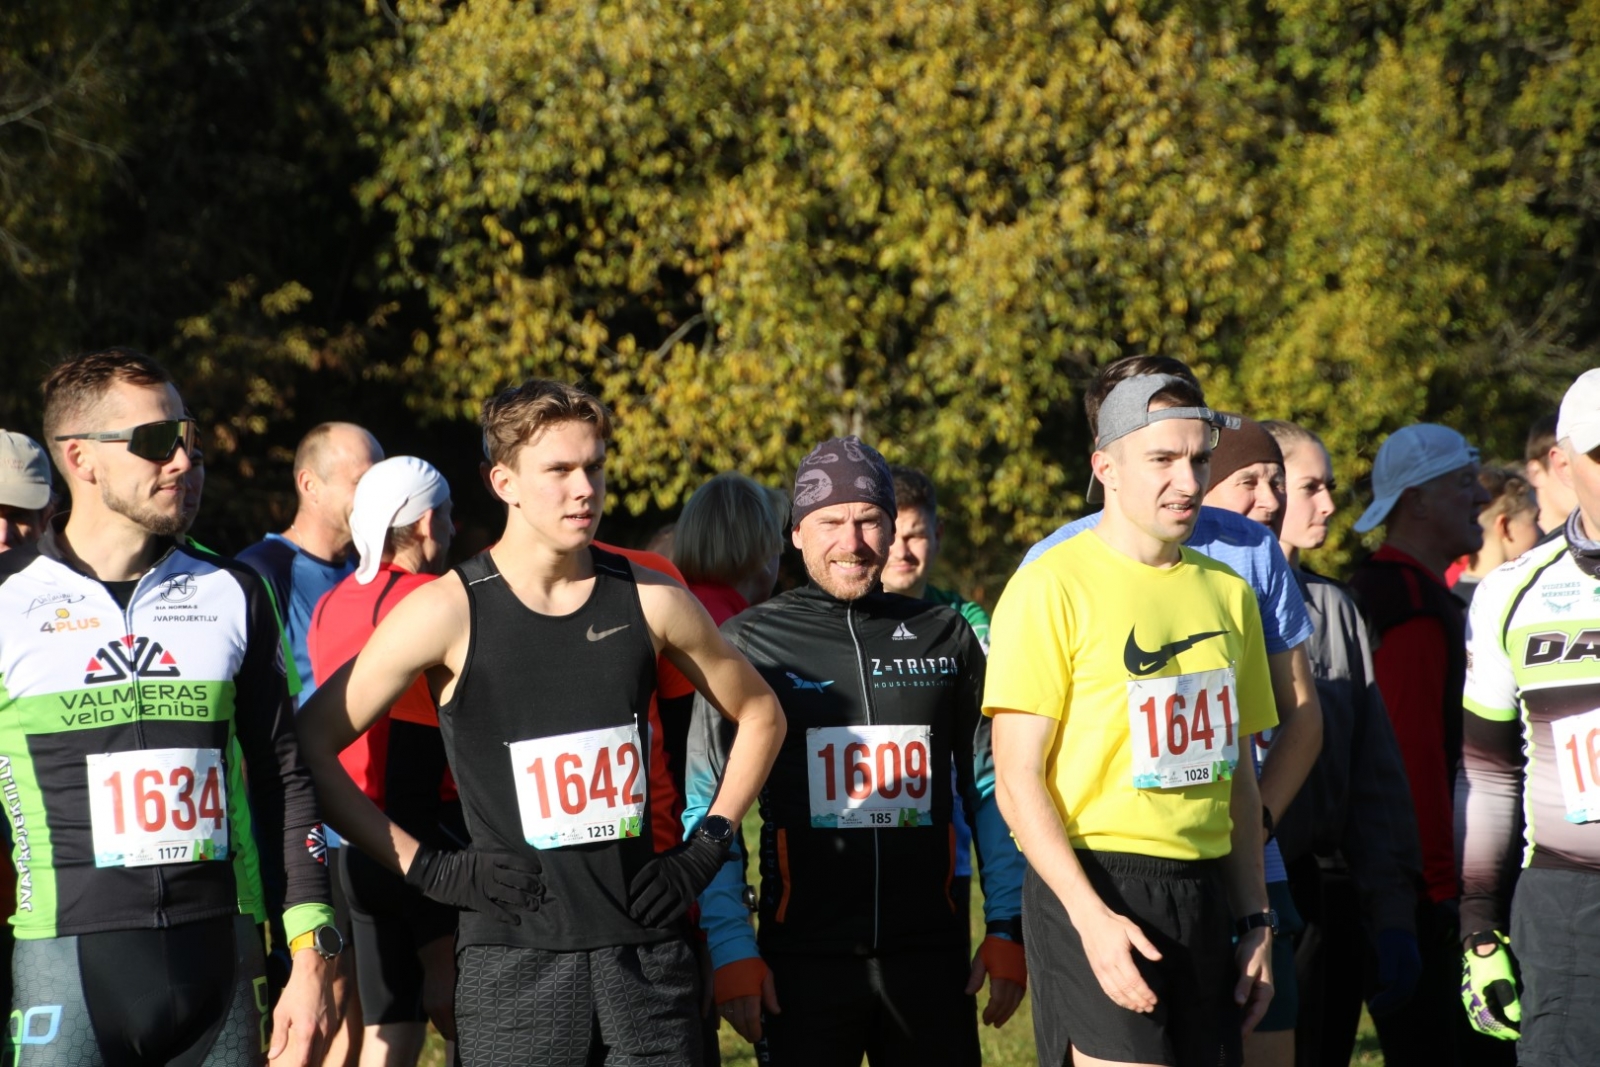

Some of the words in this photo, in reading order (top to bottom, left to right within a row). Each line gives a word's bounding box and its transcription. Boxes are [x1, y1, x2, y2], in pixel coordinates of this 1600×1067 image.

[40, 617, 101, 634] 4PLUS
[153, 614, 218, 623] JVAPROJEKTI.LV
[59, 684, 208, 711] VALMERAS
[60, 706, 115, 727] velo
[1139, 685, 1234, 759] 1641
[817, 740, 928, 801] 1609
[1184, 767, 1210, 782] 1028
[526, 741, 644, 820] 1642
[103, 765, 225, 836] 1634
[869, 812, 892, 824] 185
[586, 823, 616, 839] 1213
[157, 845, 189, 861] 1177
